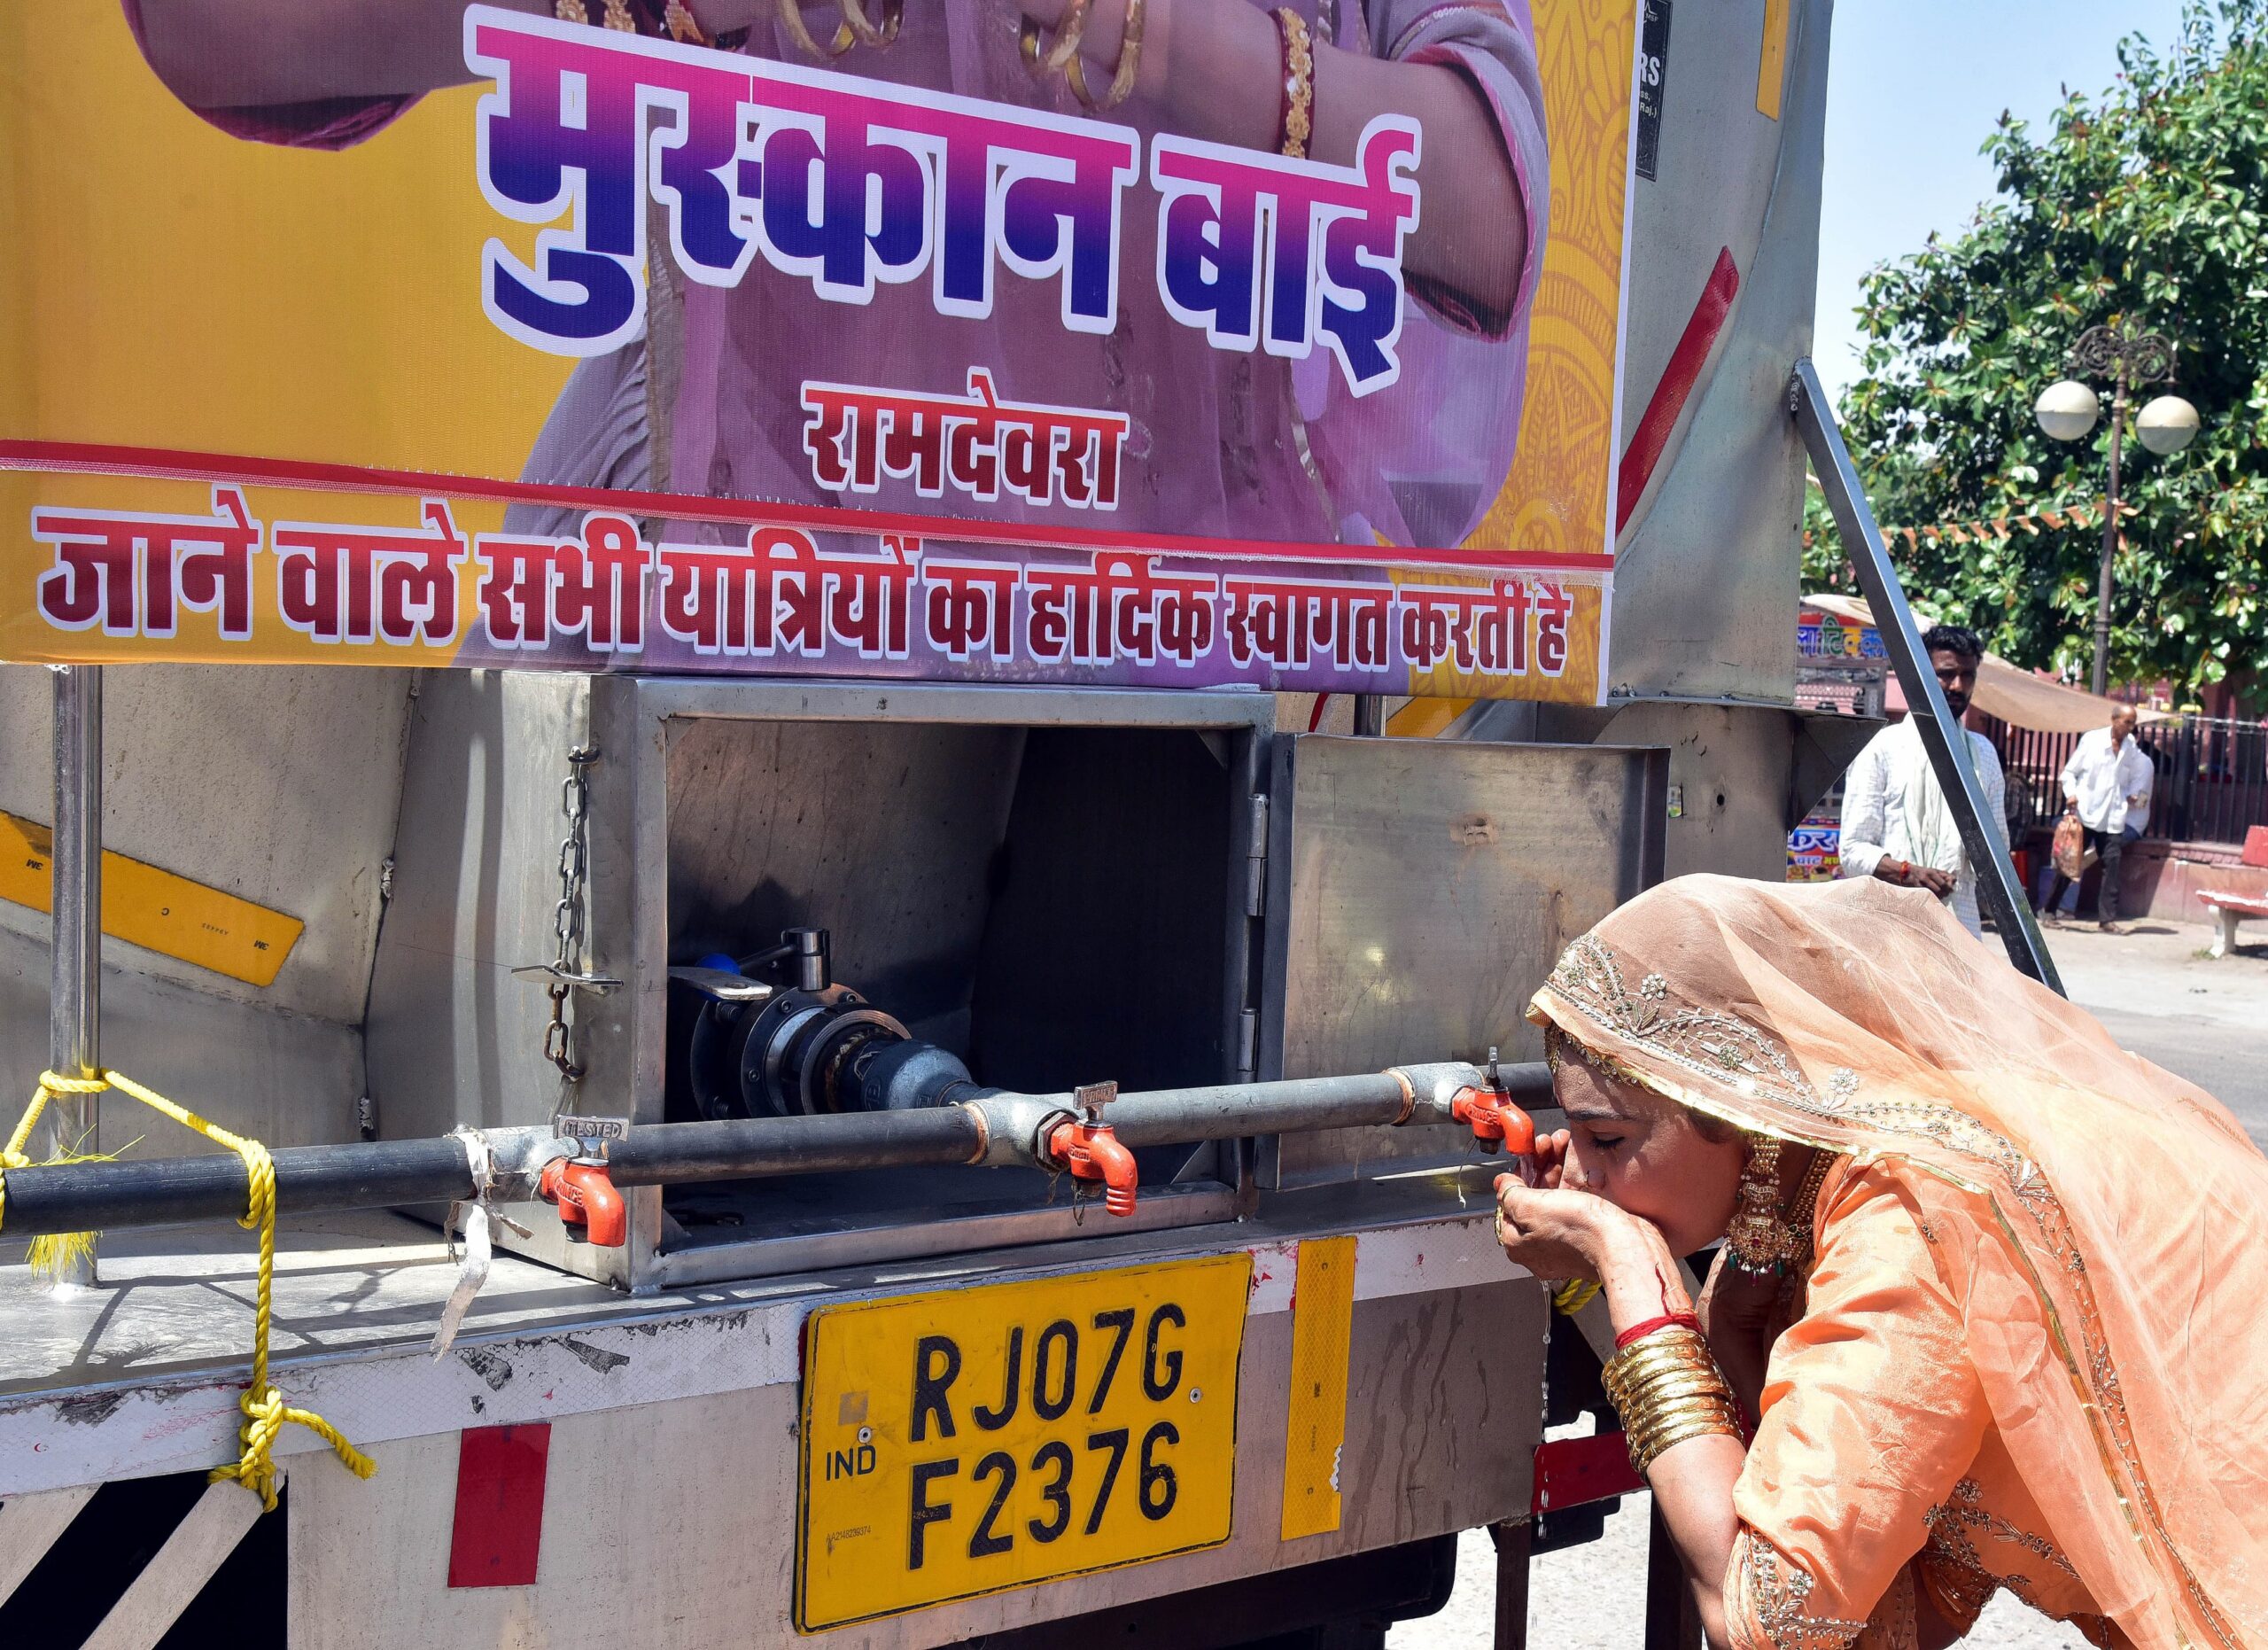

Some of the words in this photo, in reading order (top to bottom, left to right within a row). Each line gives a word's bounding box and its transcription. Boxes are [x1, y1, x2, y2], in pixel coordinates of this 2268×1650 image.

[464, 4, 1138, 357] मुस्कान
[1152, 113, 1421, 398] बाई
[800, 365, 1130, 510] रामदेवरा
[32, 484, 263, 642] जाने
[273, 496, 468, 647] वाले
[475, 510, 654, 652] सभी
[922, 557, 1022, 663] का
[1223, 573, 1394, 673] स्वागत
[1396, 577, 1534, 676] करती
[26, 859, 43, 871] 3M
[253, 939, 269, 951] 3M
[566, 1120, 622, 1139] TESTED
[826, 1444, 876, 1482] IND
[906, 1420, 1180, 1570] F2376
